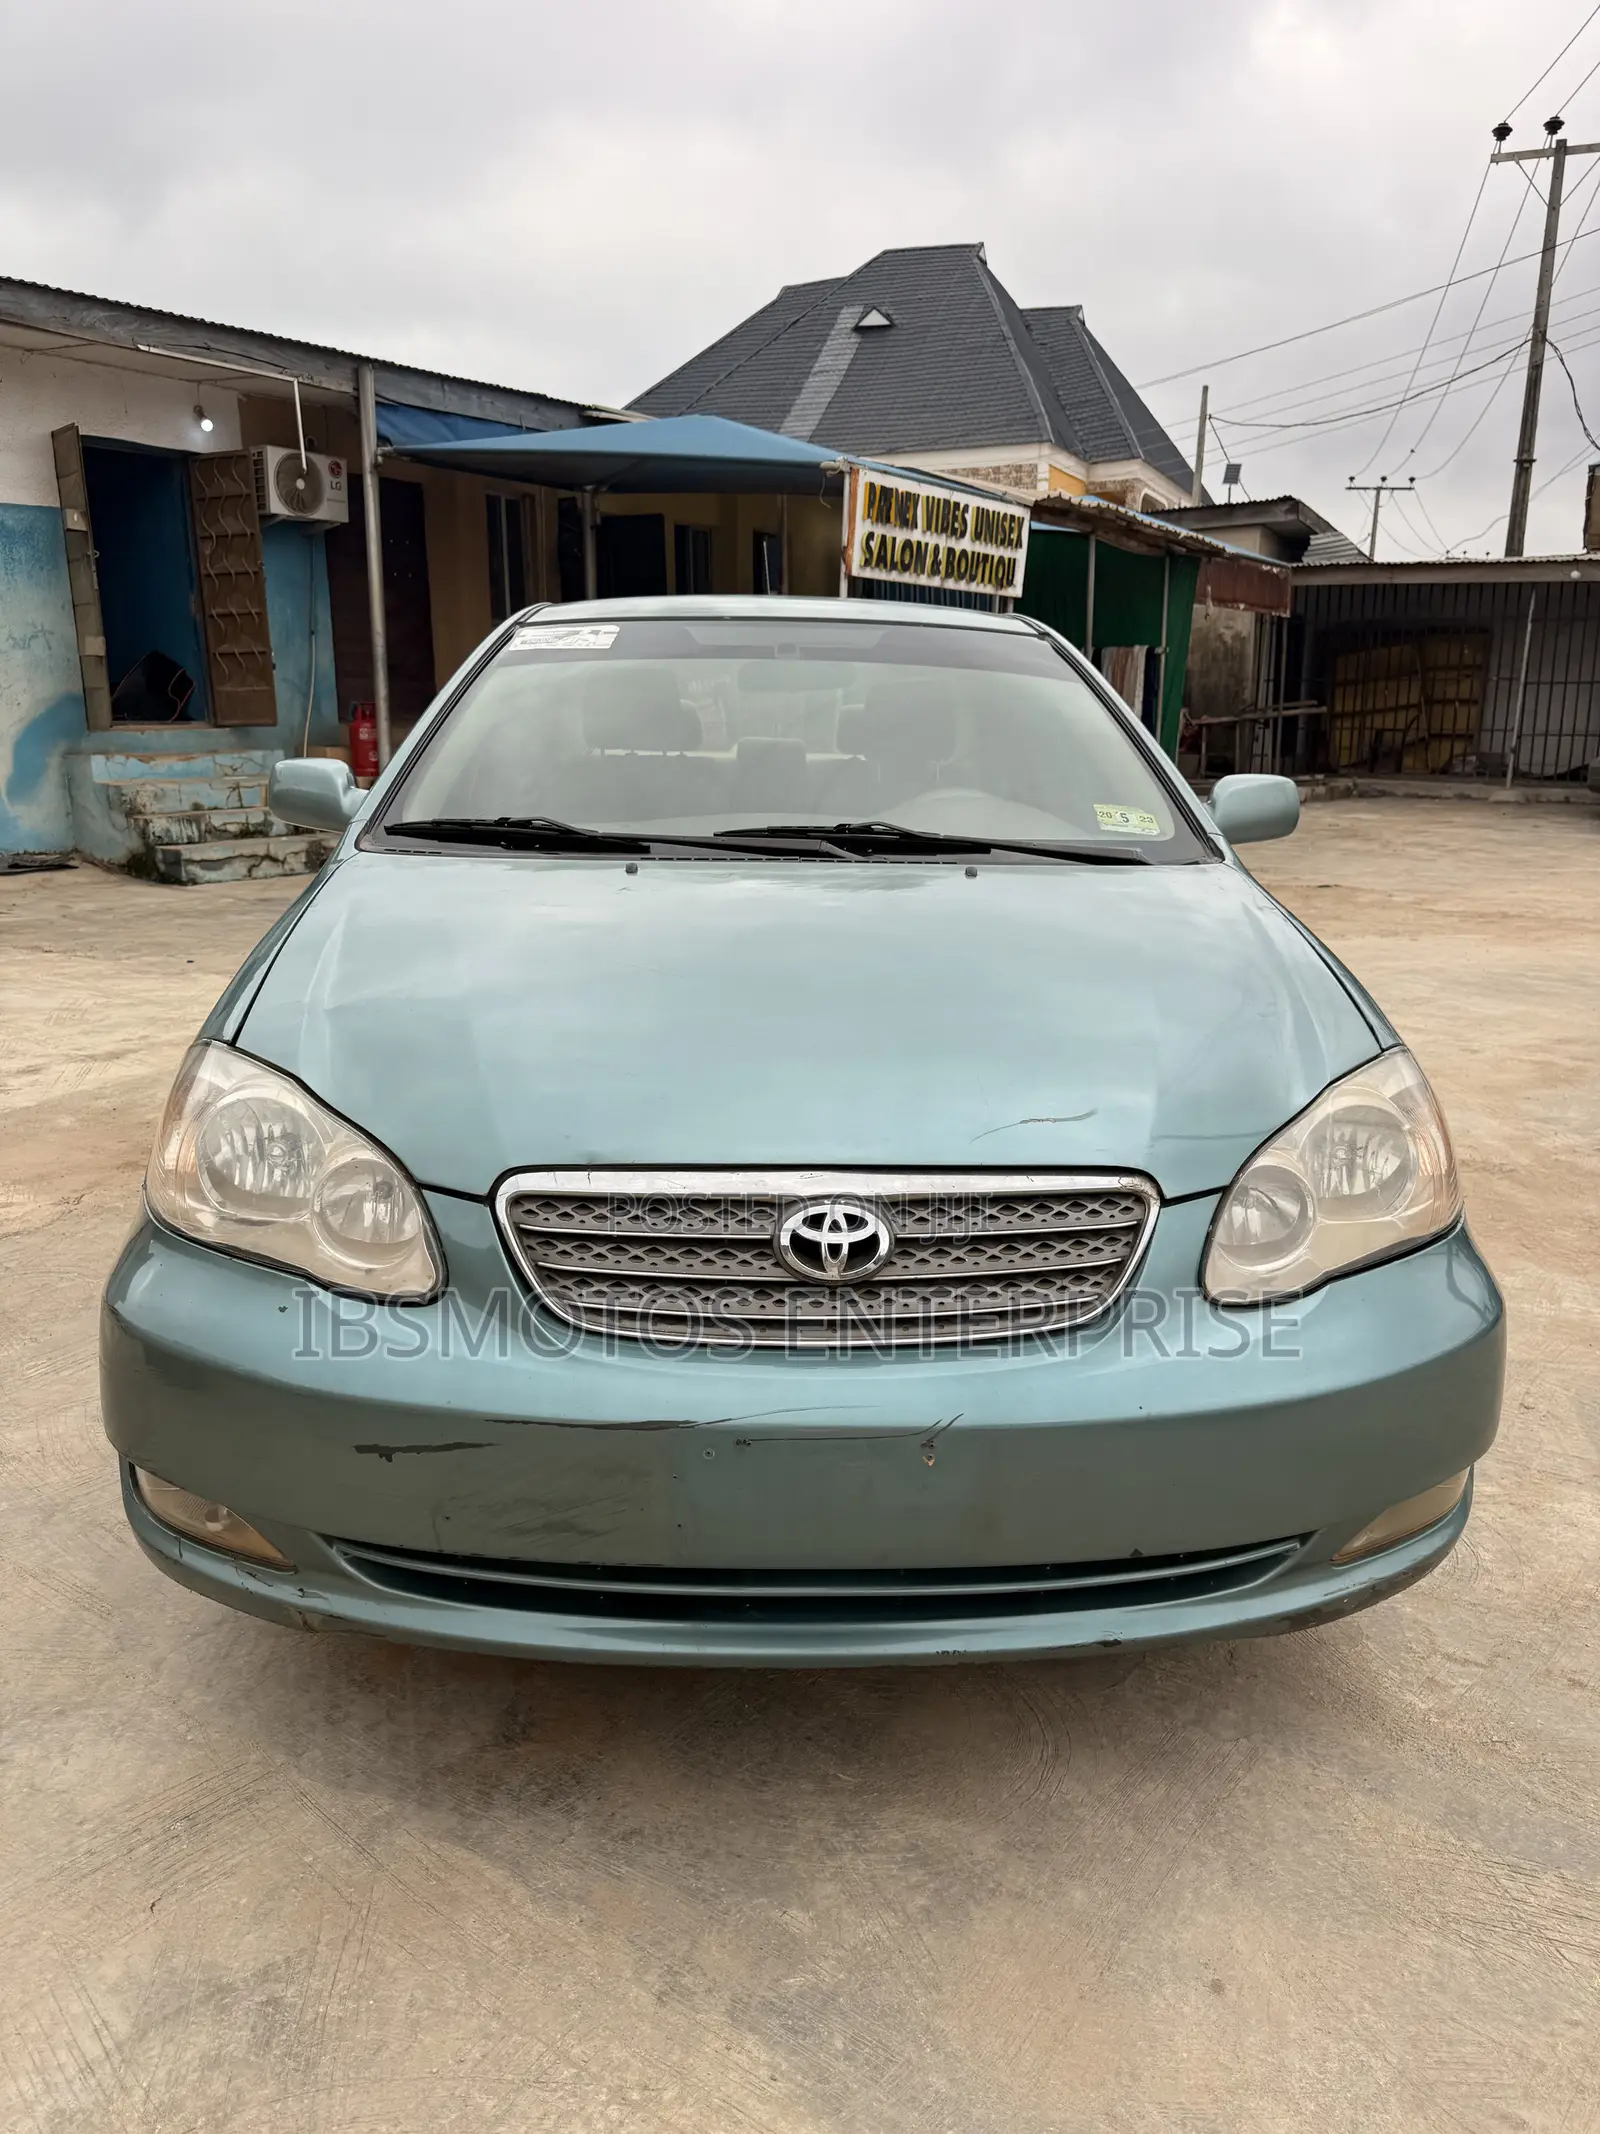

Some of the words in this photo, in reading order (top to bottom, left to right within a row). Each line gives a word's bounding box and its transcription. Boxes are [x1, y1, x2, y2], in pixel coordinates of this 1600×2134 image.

[330, 481, 342, 491] LG
[922, 495, 969, 539] VIBES
[971, 506, 1025, 549] UNISEX
[860, 531, 929, 576] SALON
[927, 543, 942, 577] &
[941, 546, 1017, 590] BOUTIQU
[1098, 811, 1113, 819] 20
[1119, 812, 1130, 823] 5
